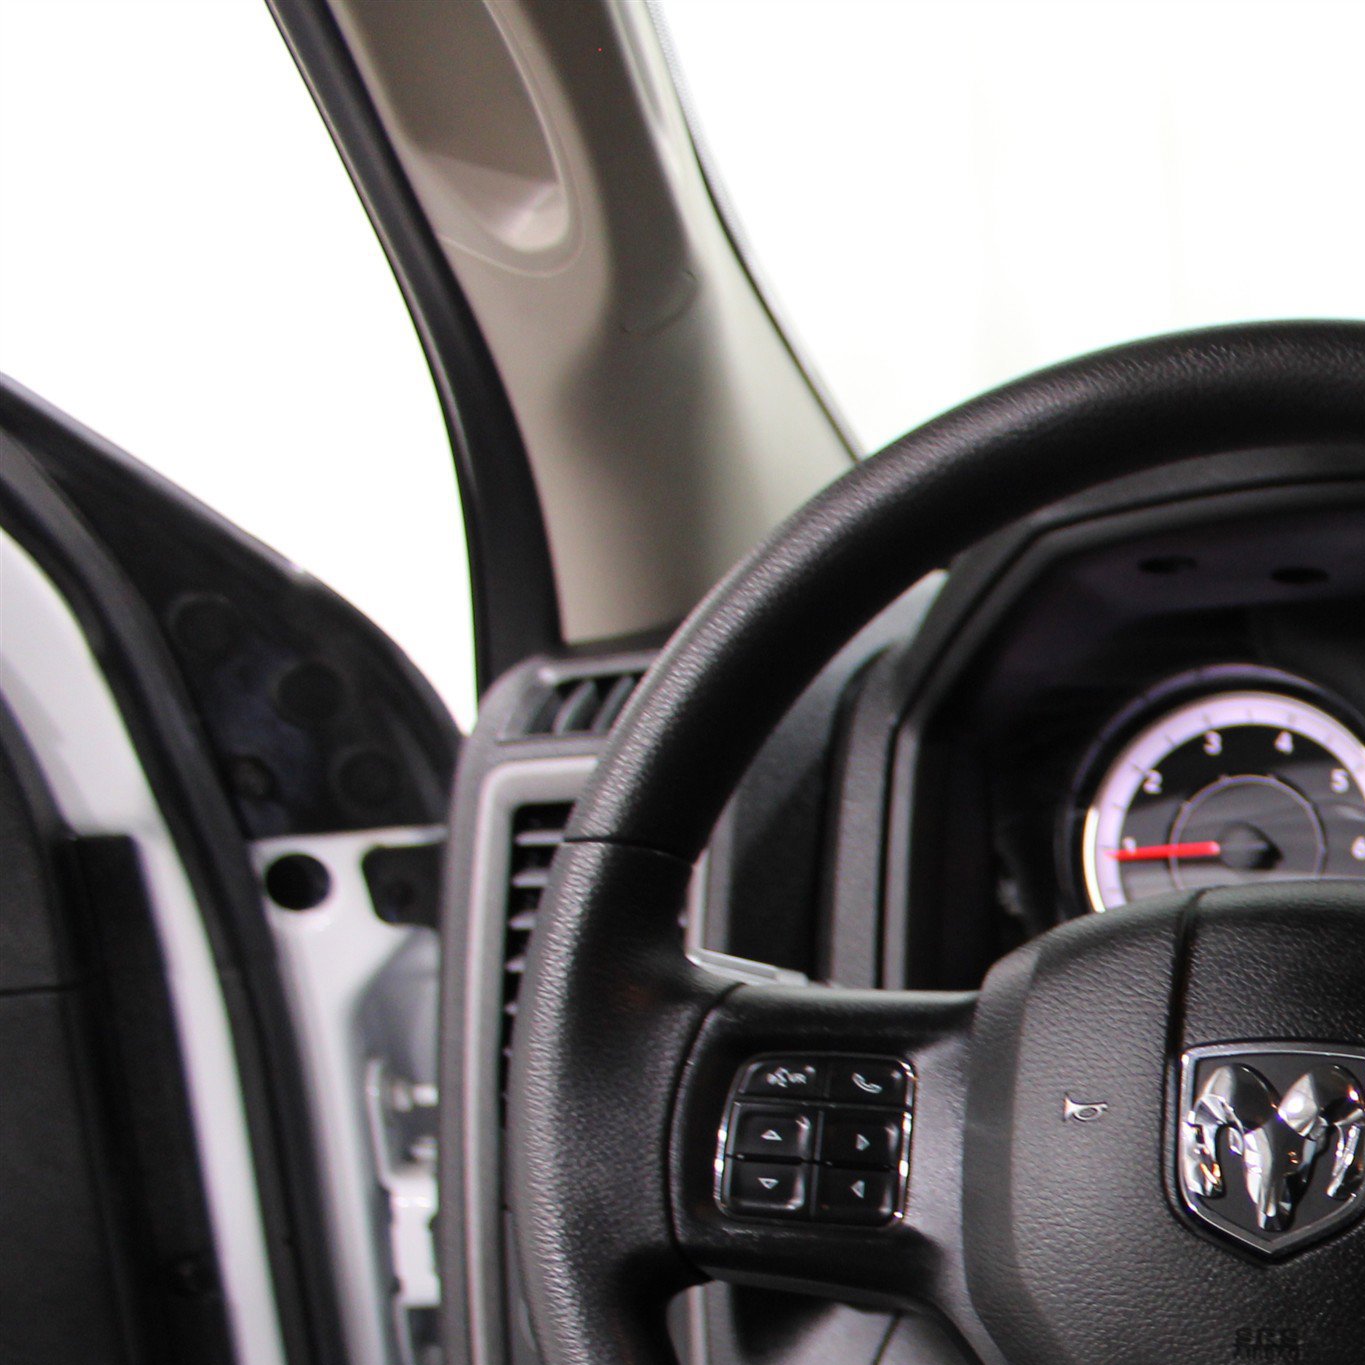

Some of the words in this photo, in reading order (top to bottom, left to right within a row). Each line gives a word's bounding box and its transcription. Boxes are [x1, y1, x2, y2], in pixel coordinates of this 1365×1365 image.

[1204, 730, 1223, 755] 3
[1274, 731, 1294, 754] 4
[1143, 768, 1163, 794] 2
[1330, 766, 1349, 793] 5
